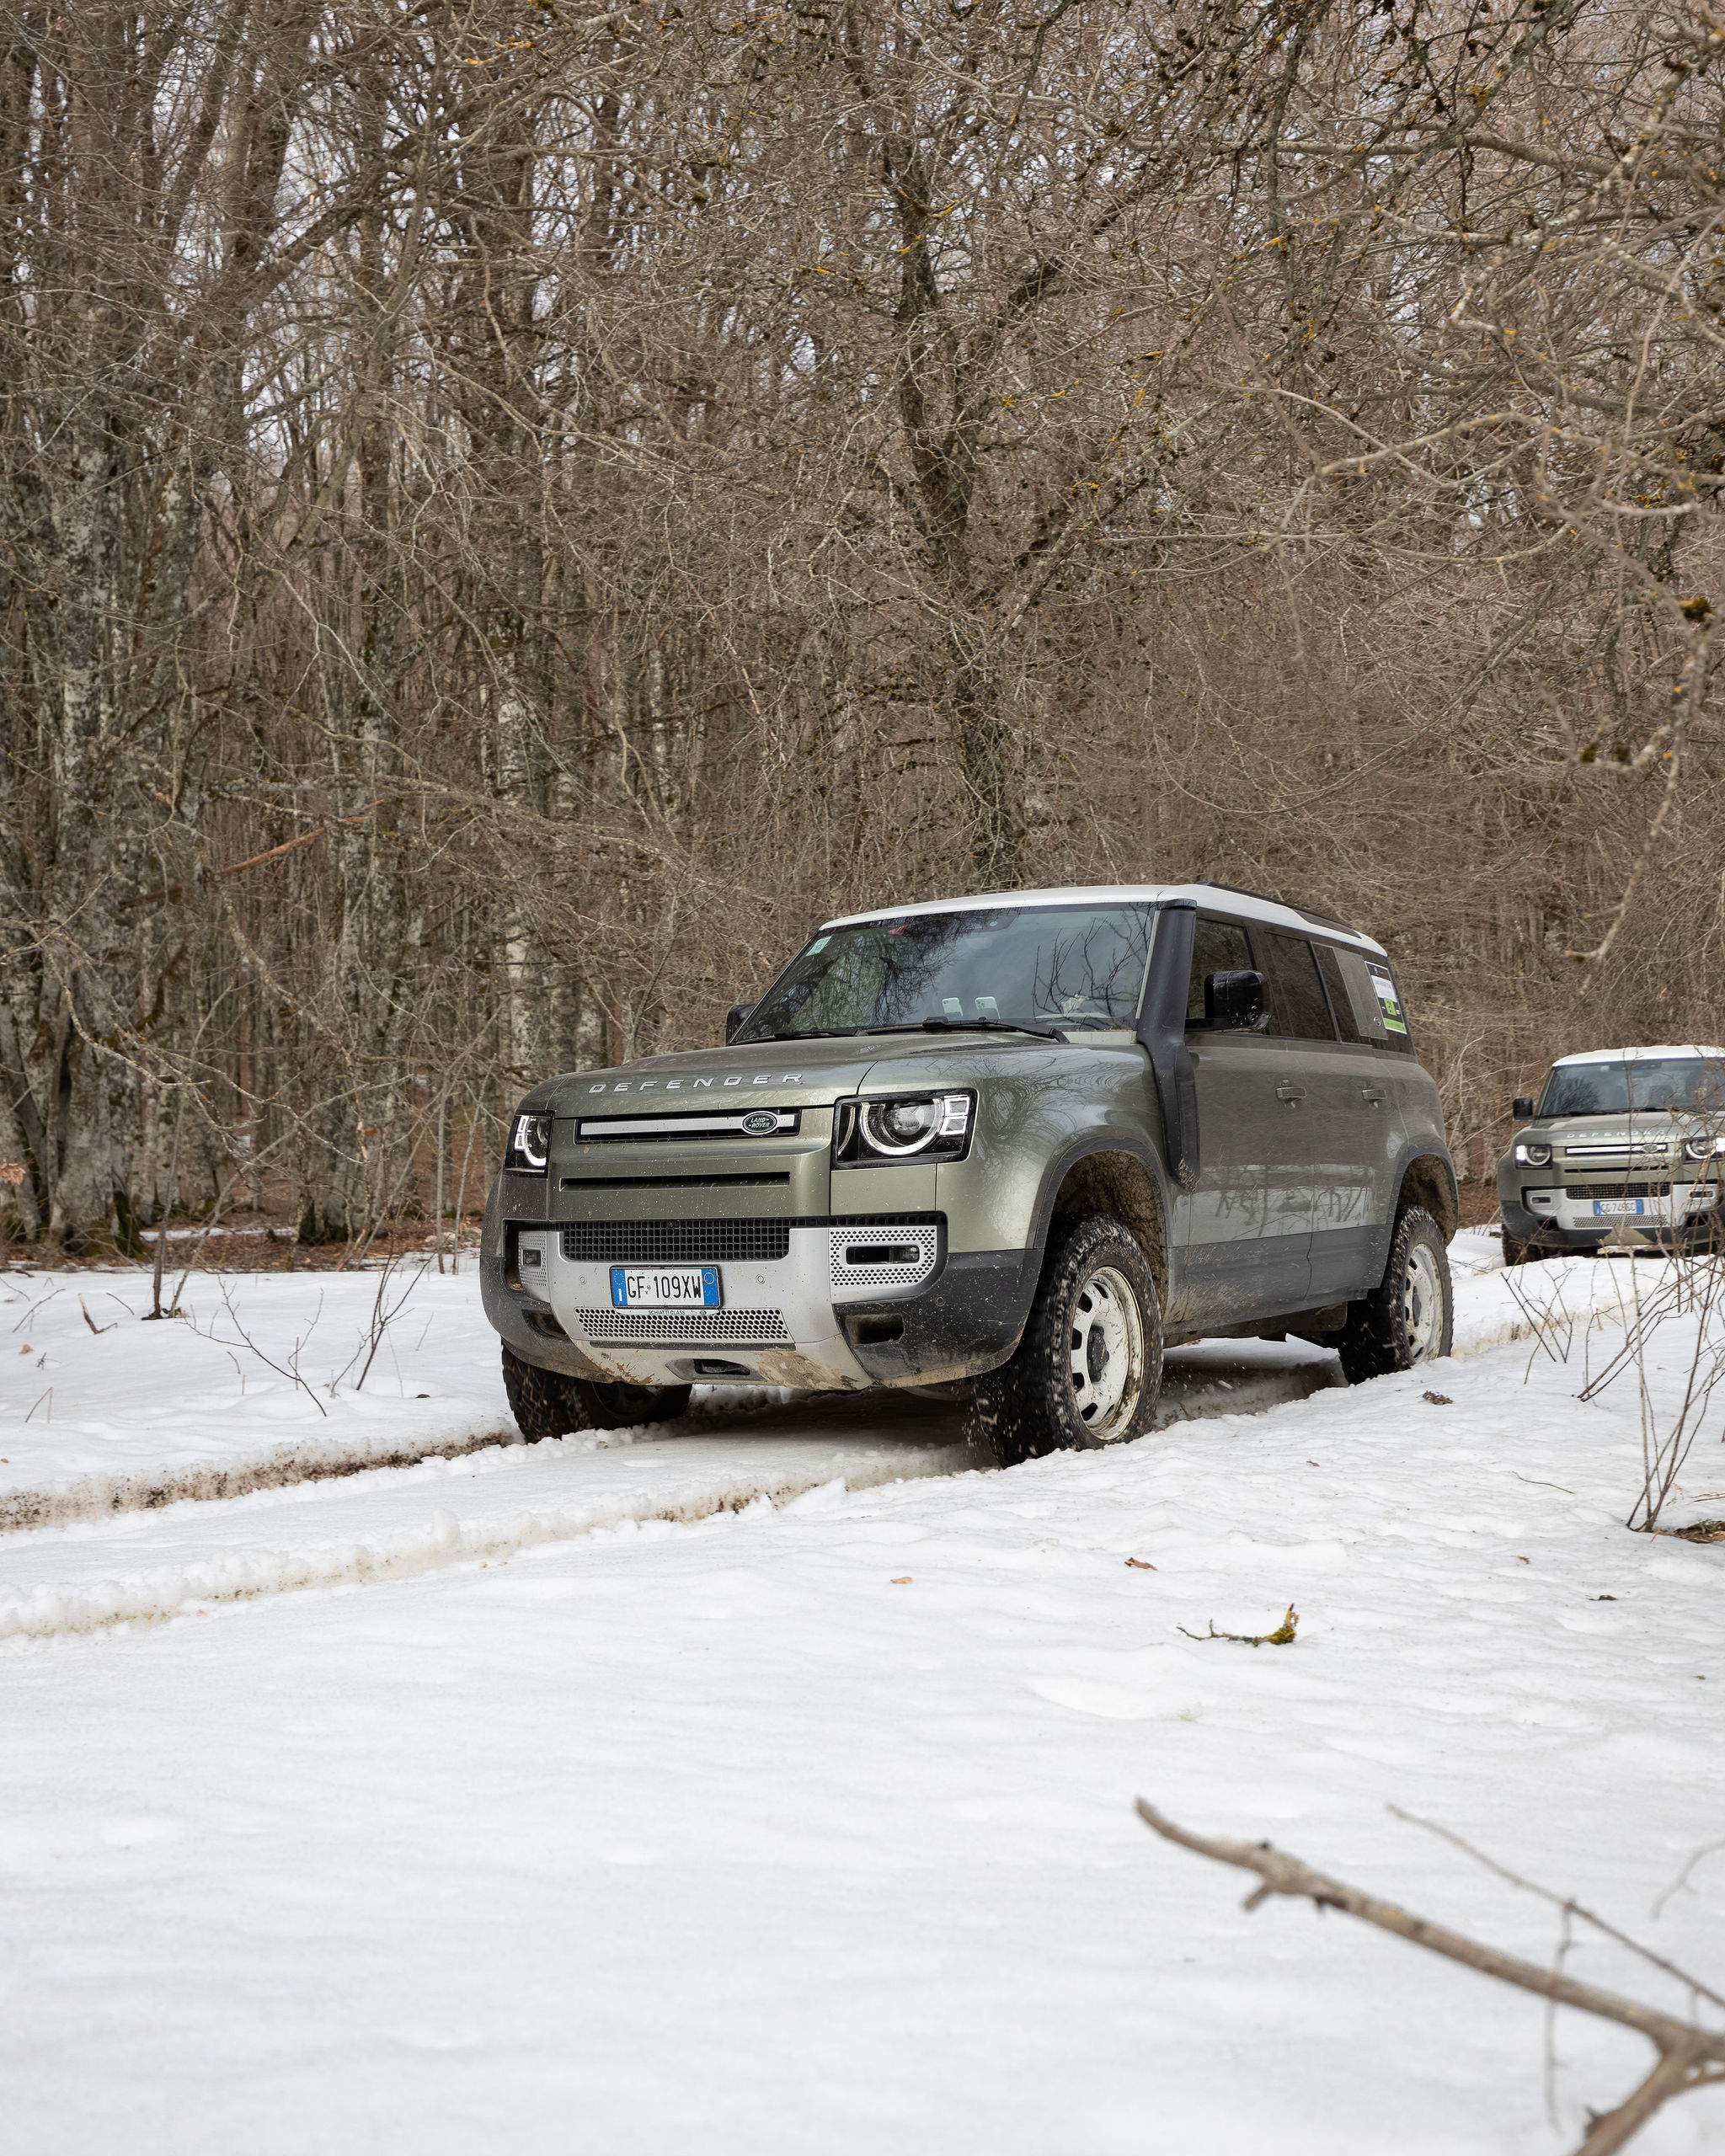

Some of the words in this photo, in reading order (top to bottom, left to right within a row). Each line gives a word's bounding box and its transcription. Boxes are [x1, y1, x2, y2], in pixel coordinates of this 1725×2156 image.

[589, 1074, 803, 1093] DEFENDER
[1567, 1129, 1665, 1138] DEFENDER
[618, 1288, 622, 1301] I
[627, 1275, 645, 1299] GF
[654, 1275, 702, 1299] 109XW
